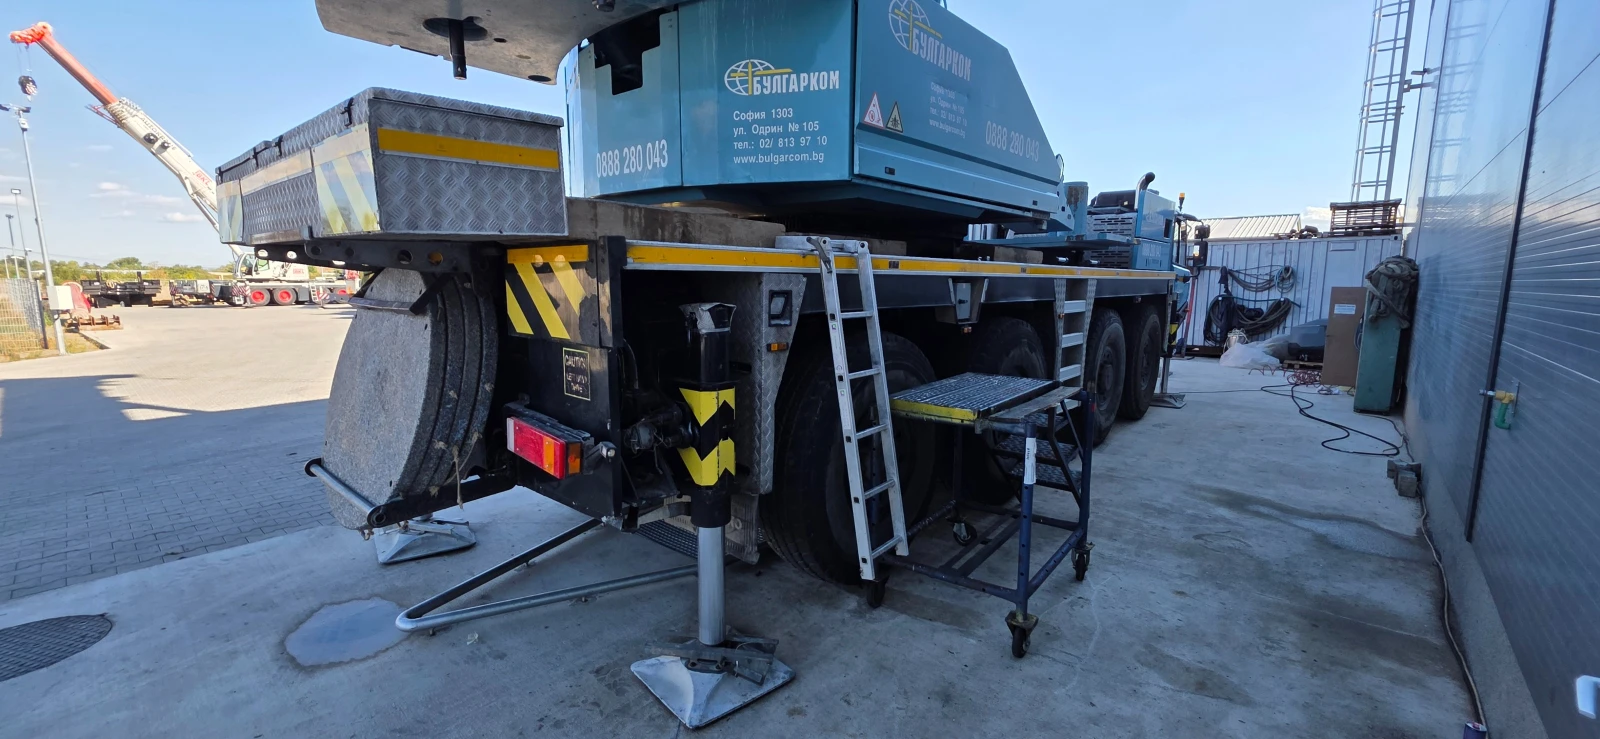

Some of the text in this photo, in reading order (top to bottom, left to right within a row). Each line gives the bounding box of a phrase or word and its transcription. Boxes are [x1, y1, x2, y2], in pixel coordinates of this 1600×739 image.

[912, 28, 971, 81] БУЛГАРКОМ
[752, 70, 840, 96] БУЛГАРКОМ
[733, 107, 793, 122] София 1303
[733, 121, 819, 138] ул. Одрин № 105
[733, 136, 828, 150] тел.: 02/ 813 97 10
[986, 121, 1040, 163] 0888 280 043
[596, 139, 668, 178] 0888 280 043
[733, 151, 825, 166] www.bulgarcom.bg
